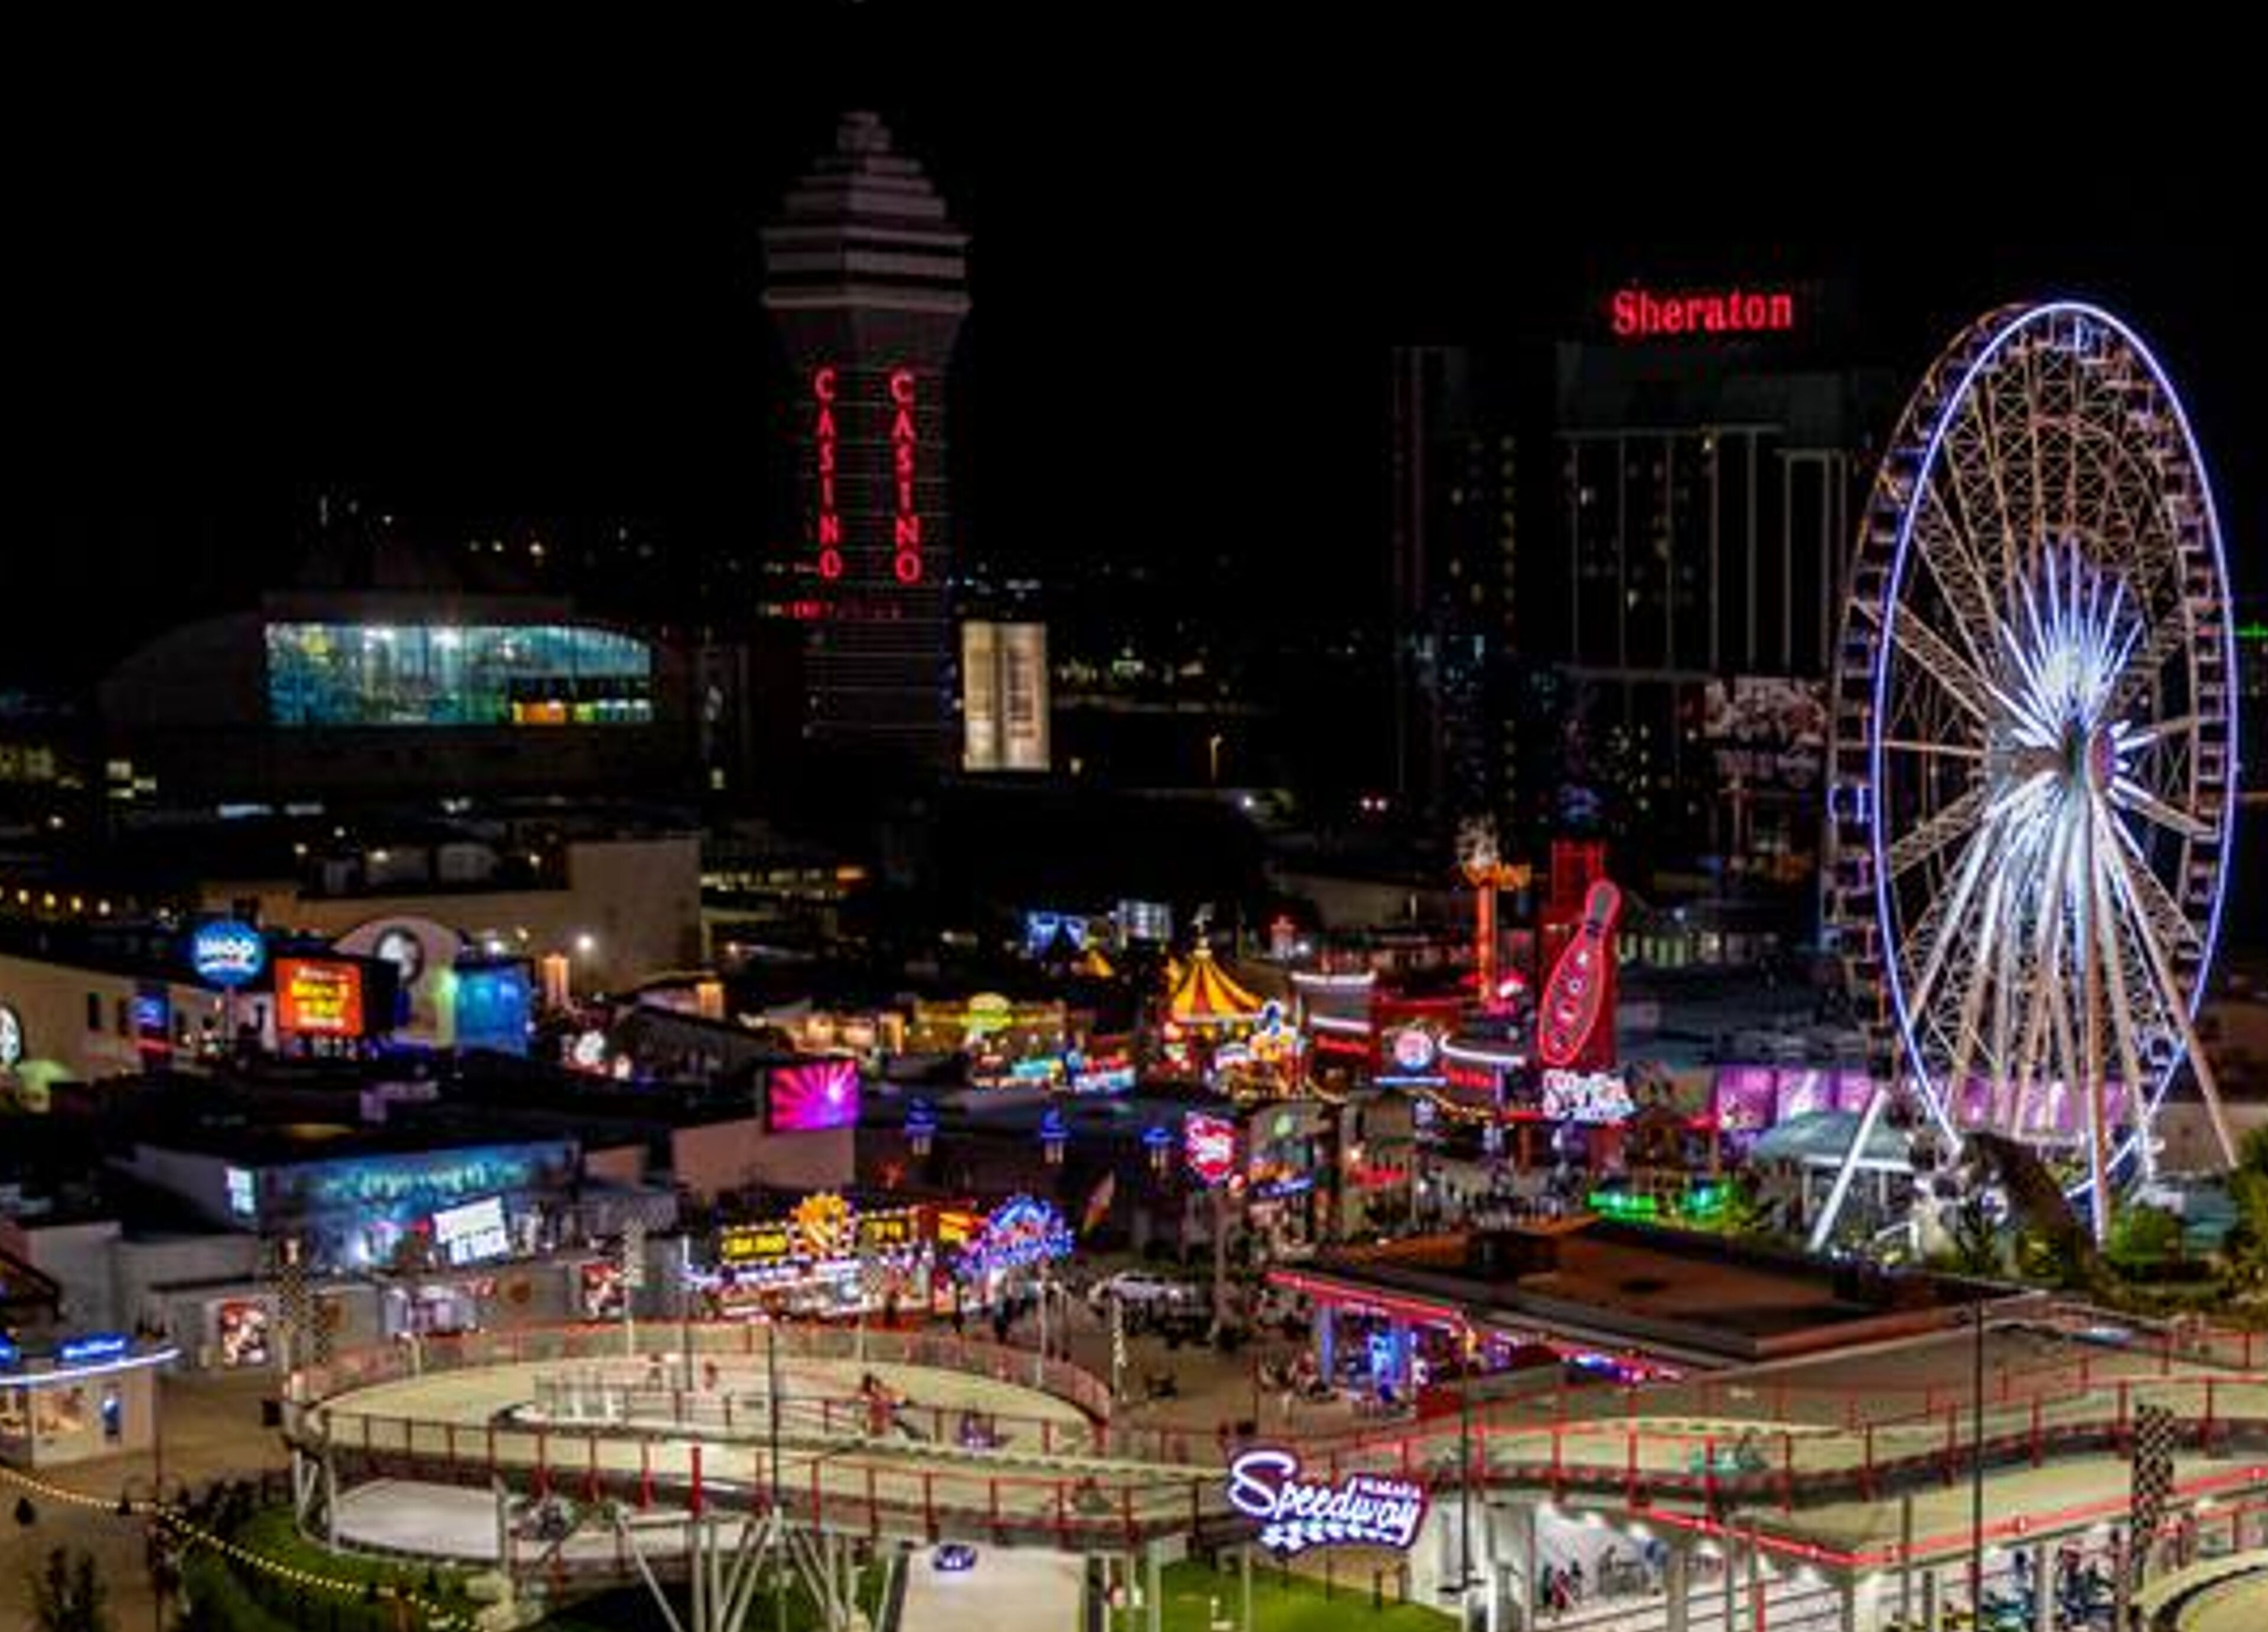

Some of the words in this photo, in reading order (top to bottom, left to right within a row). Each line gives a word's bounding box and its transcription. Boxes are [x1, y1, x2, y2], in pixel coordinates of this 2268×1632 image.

[1612, 288, 1792, 335] Sheraton
[814, 368, 843, 580] CASINO
[891, 371, 923, 583] CASINO
[1228, 1450, 1421, 1546] Speedway
